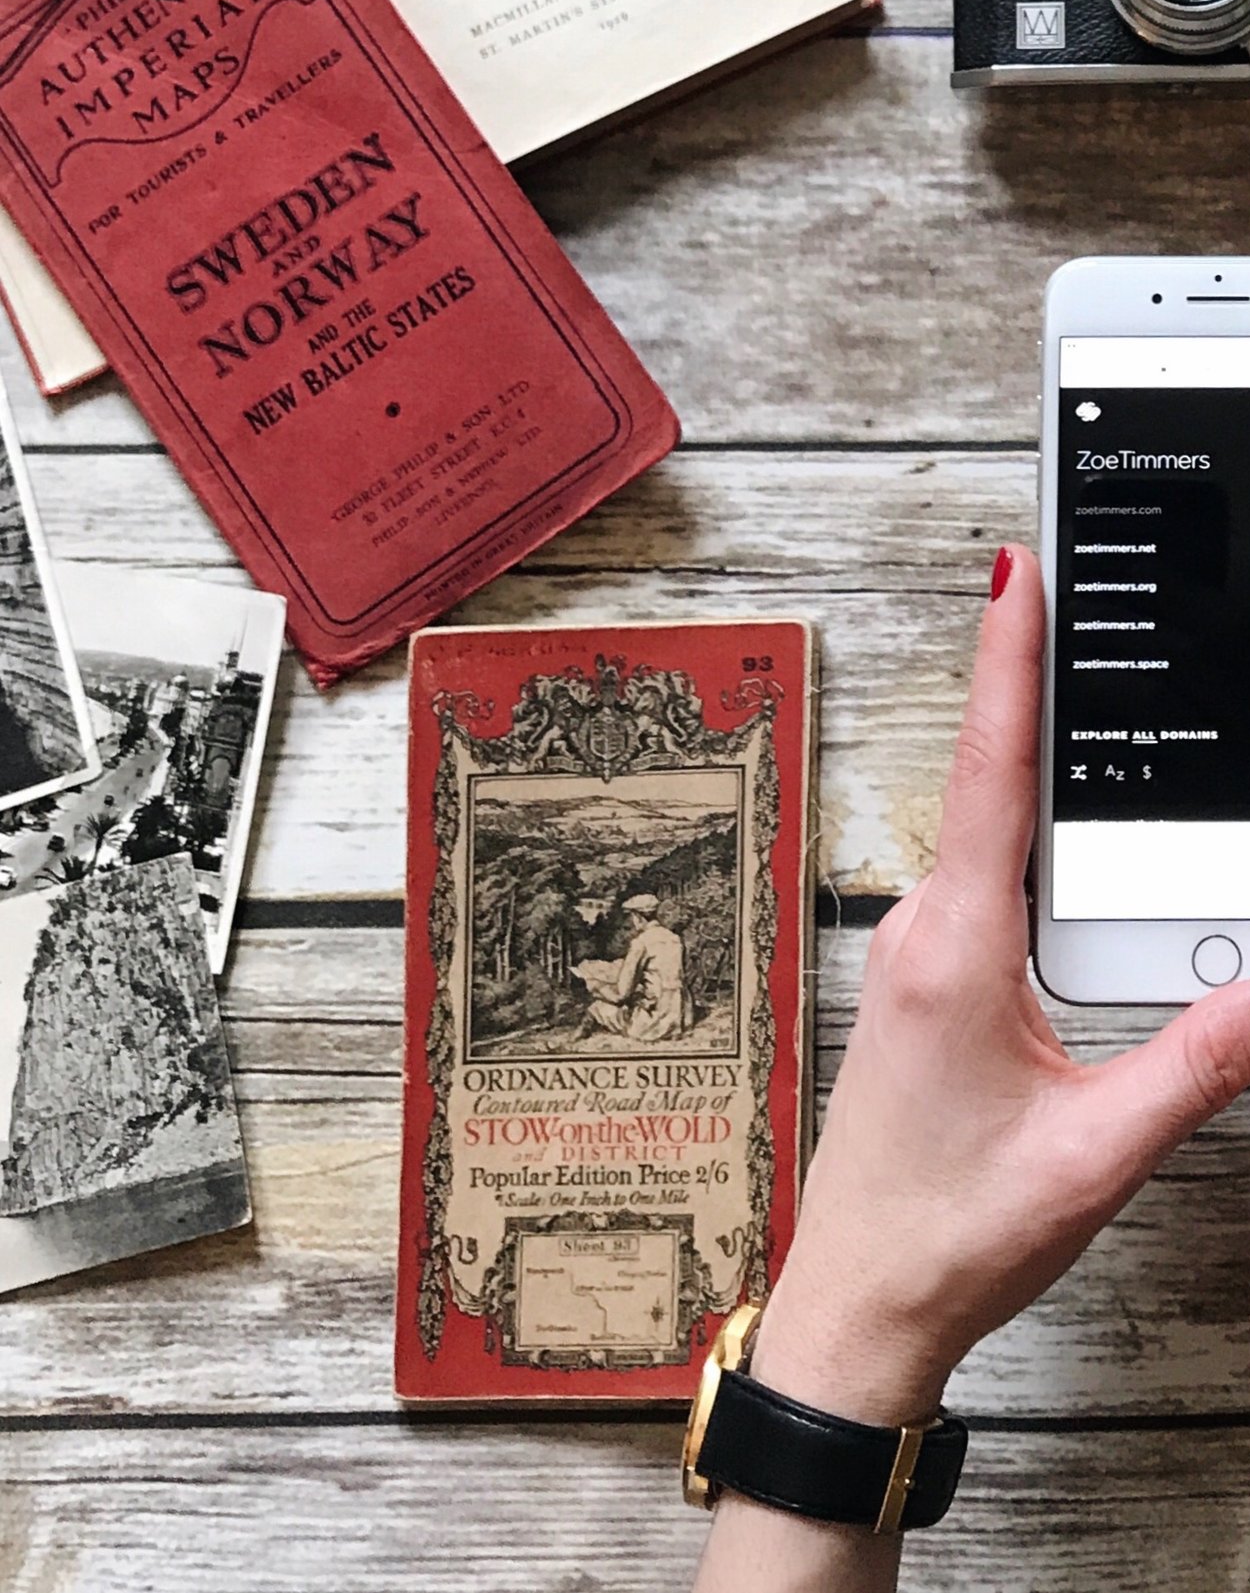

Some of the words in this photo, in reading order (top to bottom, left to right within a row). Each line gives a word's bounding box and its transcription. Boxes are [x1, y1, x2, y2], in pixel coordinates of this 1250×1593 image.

[508, 8, 584, 48] MARTIN'S
[131, 45, 241, 135] MAPS
[88, 204, 123, 236] FOR
[125, 143, 208, 206] TOURISTS
[233, 48, 343, 130] TRAVELLERS
[164, 131, 397, 313] SWEDEN
[271, 235, 321, 278] AND
[197, 191, 431, 379] NORWAY
[306, 324, 340, 355] AND
[342, 297, 377, 329] THE
[242, 382, 298, 436] NEW
[301, 324, 388, 397] BALTIC
[385, 265, 477, 339] STATES
[1075, 449, 1211, 471] ZoeTimmers
[1075, 506, 1162, 516] zoetimmers.com
[1073, 543, 1158, 554] zoetimmers.net
[1073, 580, 1158, 594] zoetimmers.org
[1073, 619, 1156, 631] zoetimmers.me
[741, 656, 775, 673] 93
[1072, 657, 1170, 670] zoetimmers.space
[1071, 730, 1129, 741] EXPLORE
[1132, 730, 1157, 741] ALL
[1159, 730, 1219, 741] DOMAINS
[463, 1064, 629, 1094] ORDNANCE
[635, 1063, 744, 1090] SURVEY
[472, 1092, 579, 1117] Contoured
[583, 1090, 647, 1116] Road
[649, 1089, 708, 1115] Map
[710, 1088, 739, 1114] of
[561, 1144, 688, 1163] DISTRICT
[469, 1165, 552, 1191] Popular
[554, 1164, 633, 1188] Edition
[637, 1163, 692, 1186] Price
[694, 1157, 731, 1195] 2/6
[656, 1189, 691, 1205] Mile
